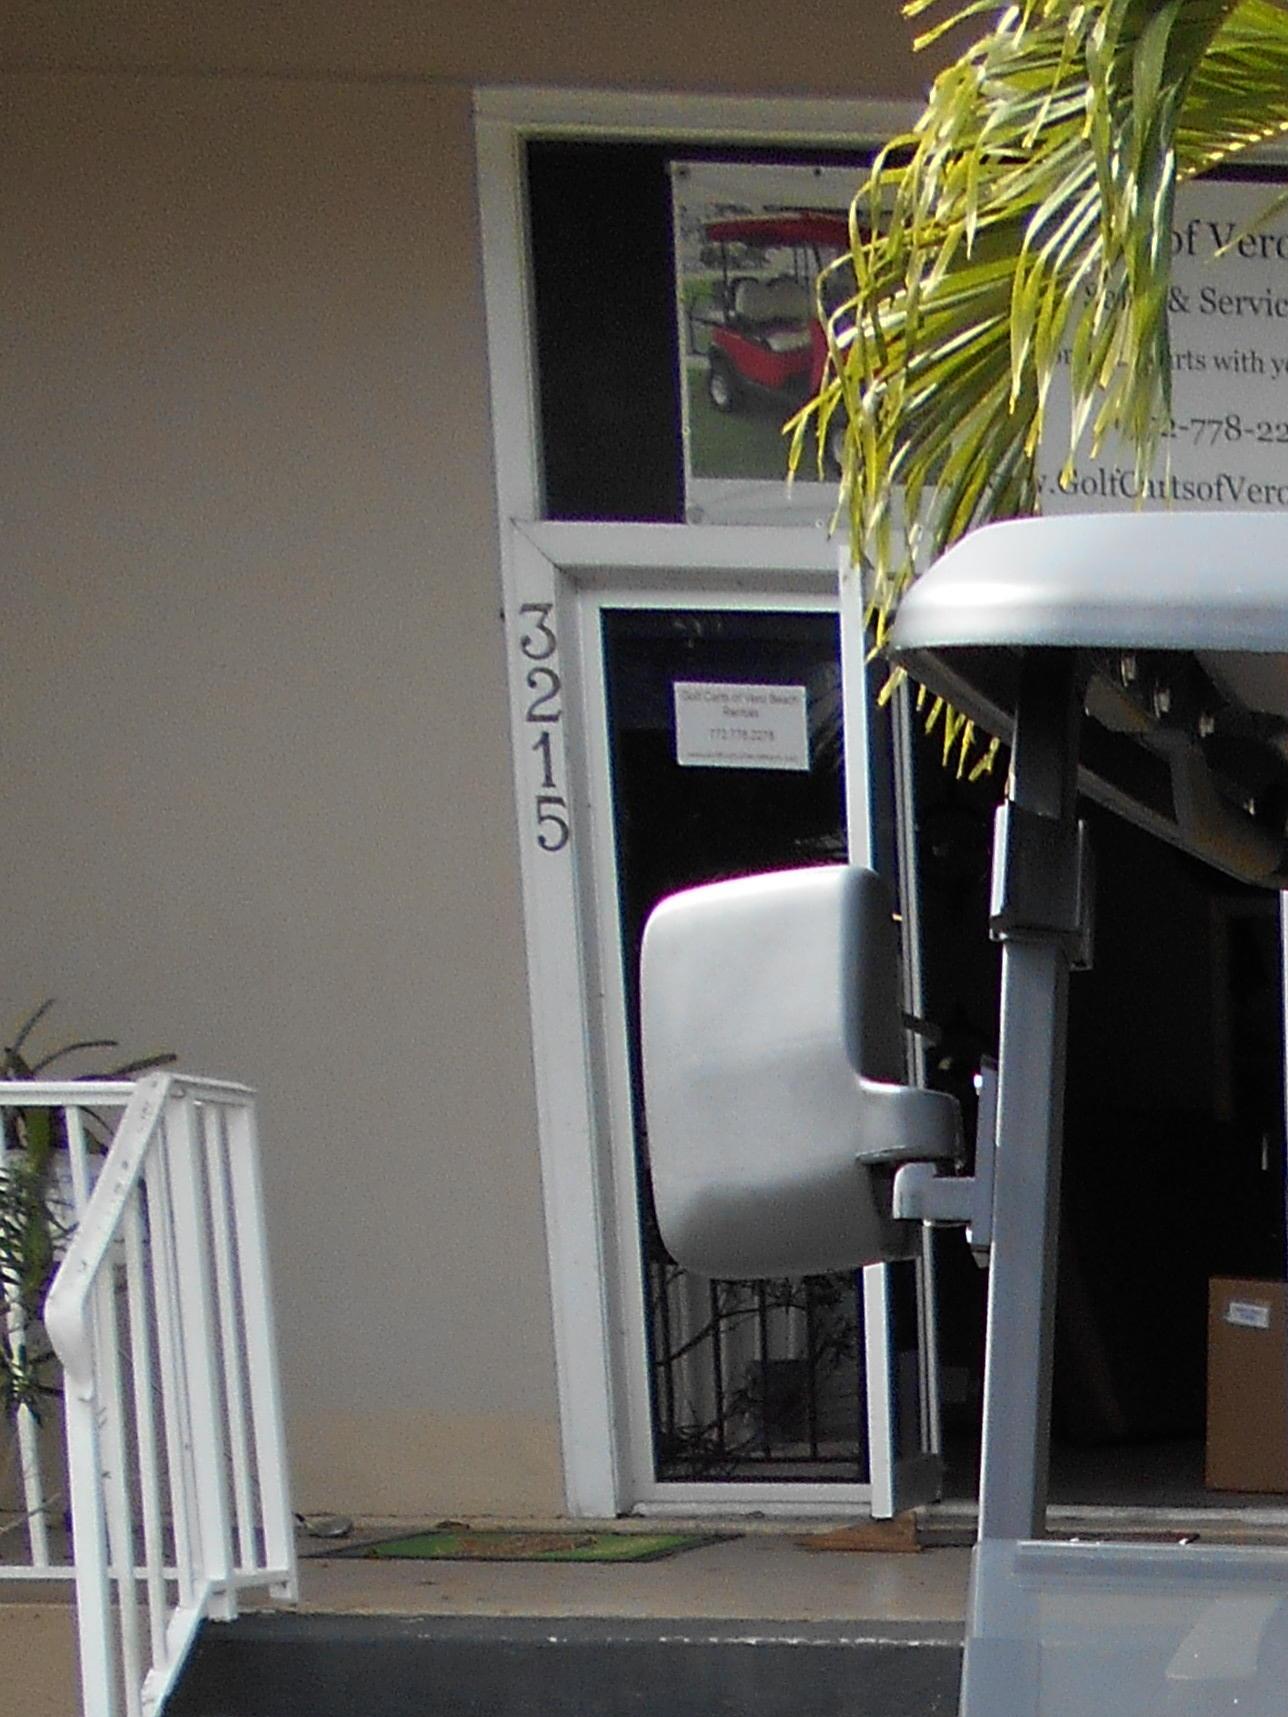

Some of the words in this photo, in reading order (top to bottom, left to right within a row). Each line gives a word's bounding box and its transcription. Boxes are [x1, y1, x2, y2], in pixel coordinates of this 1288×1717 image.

[1168, 286, 1190, 314] &
[1213, 350, 1265, 375] with
[520, 603, 570, 852] 3215
